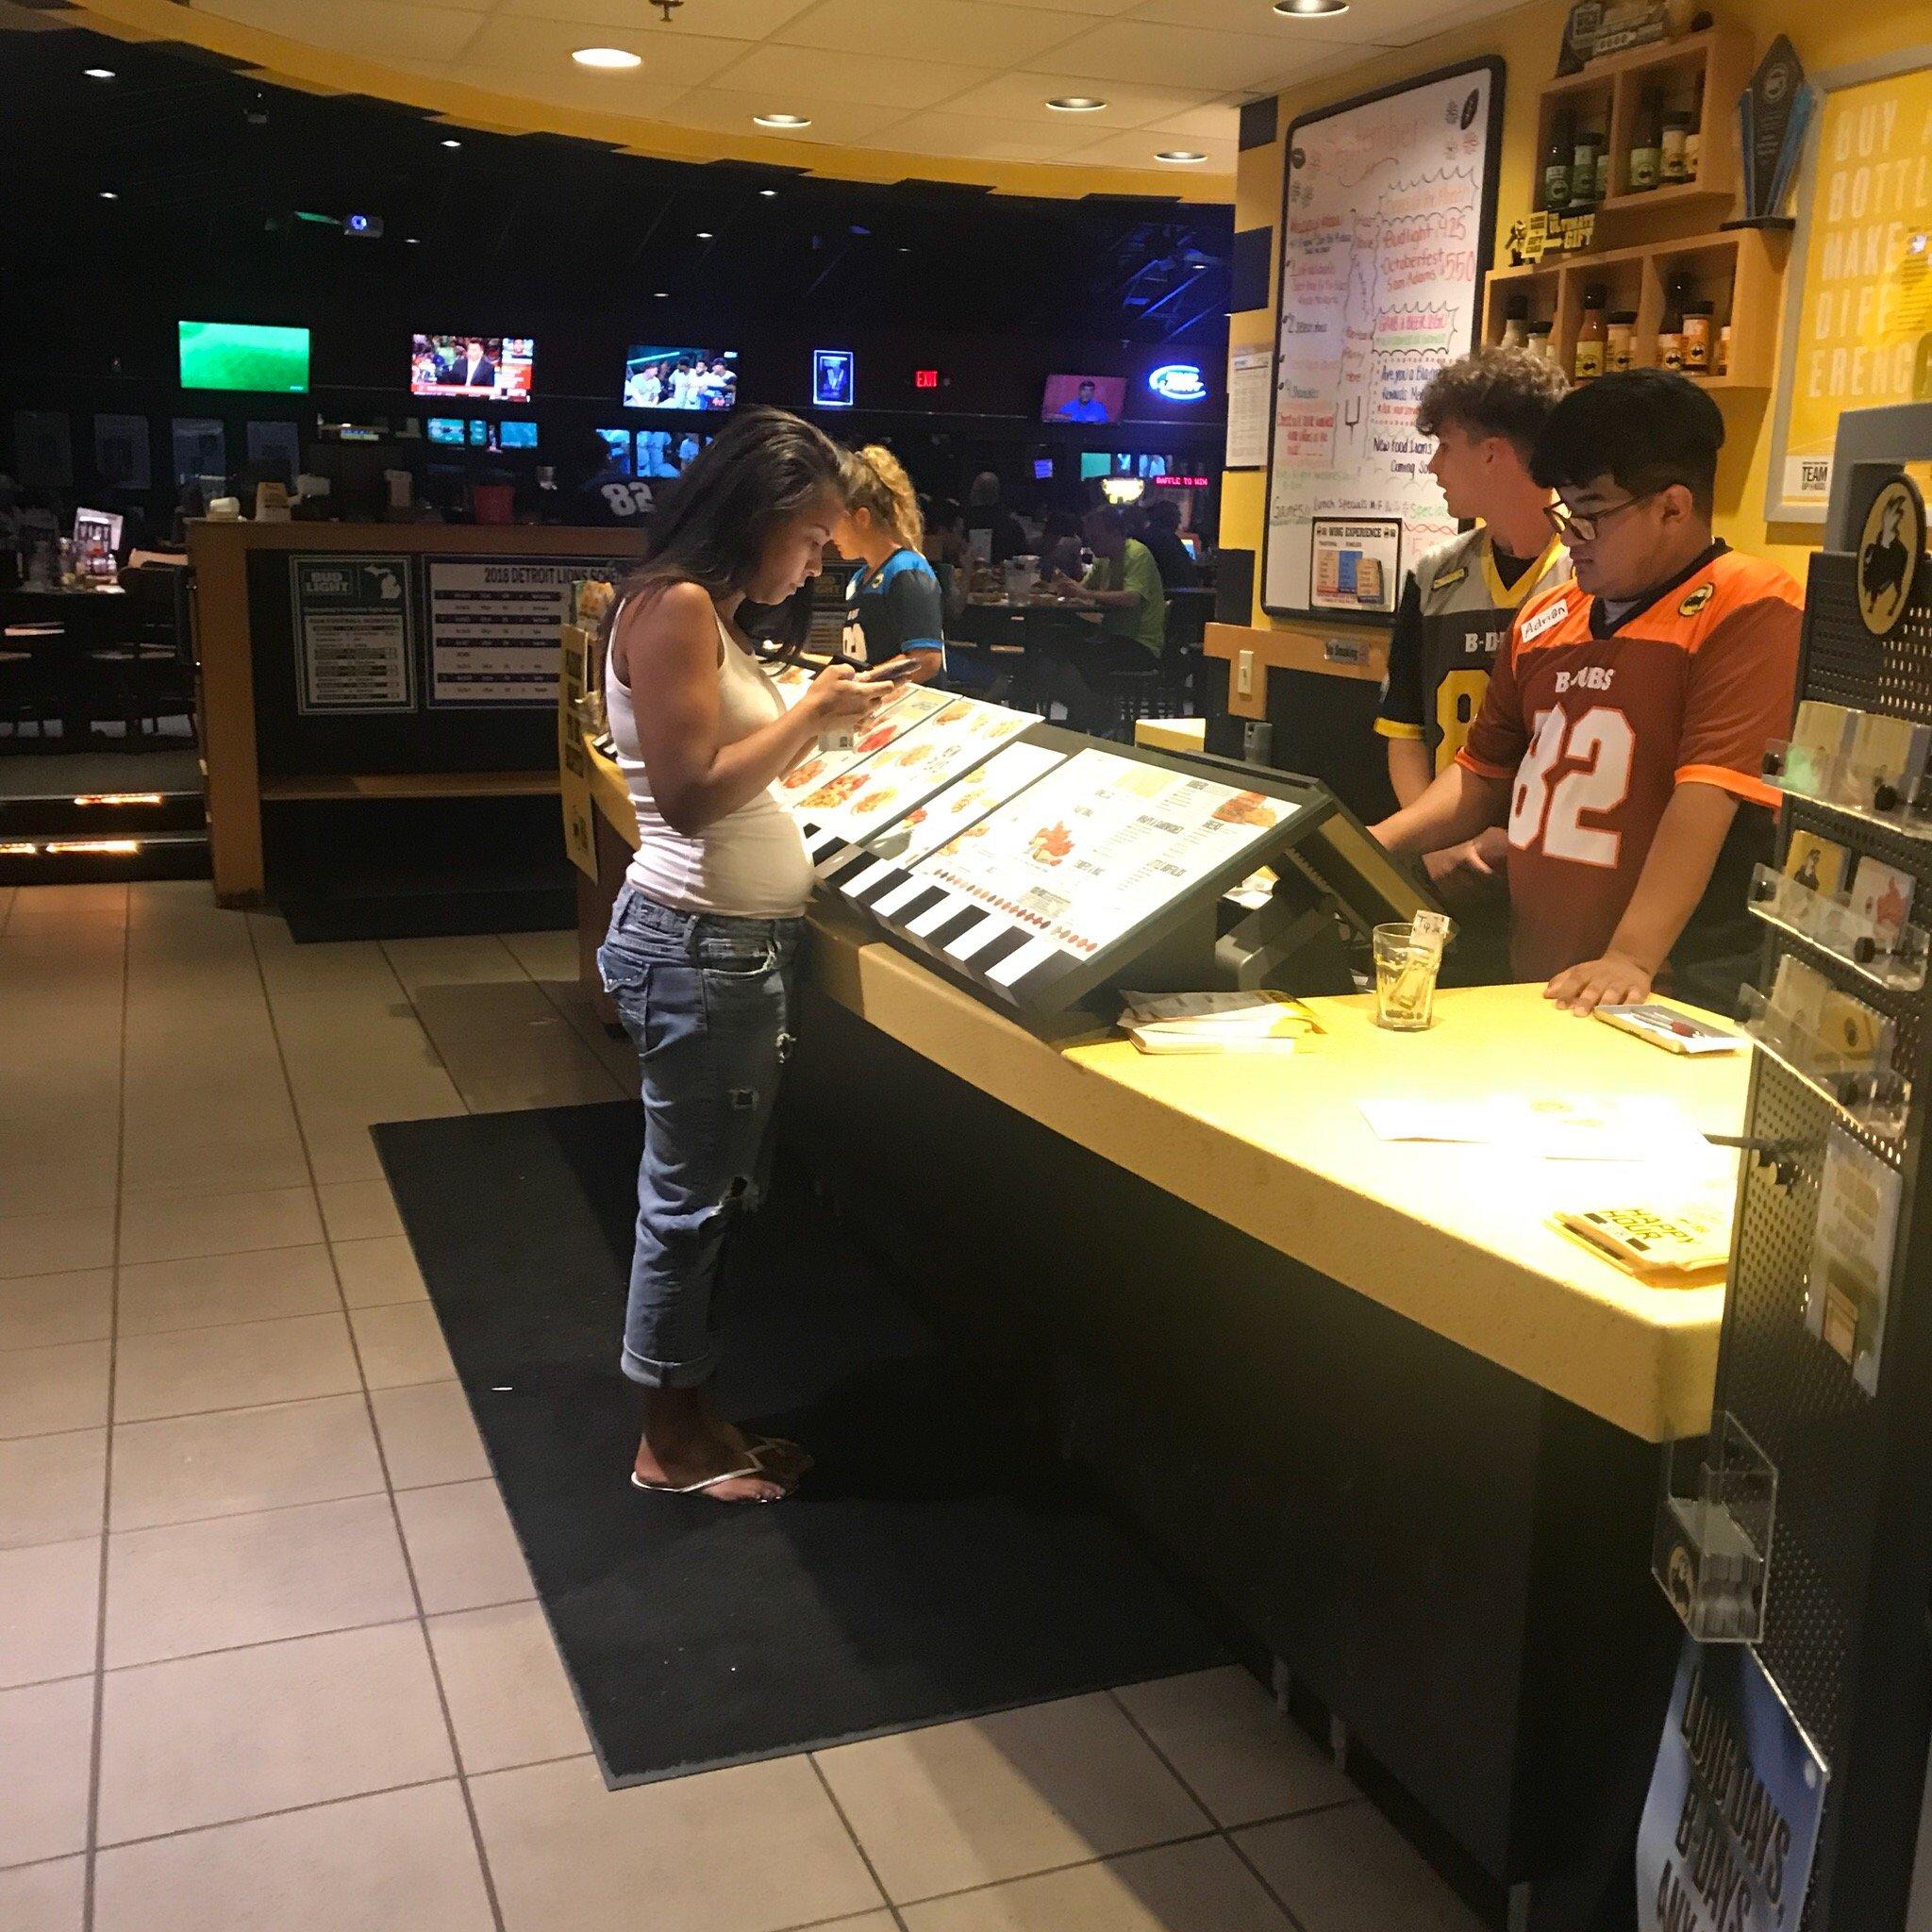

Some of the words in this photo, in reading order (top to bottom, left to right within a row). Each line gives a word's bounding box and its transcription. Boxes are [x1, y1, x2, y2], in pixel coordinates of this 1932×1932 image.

[1835, 99, 1898, 162] BUY
[1827, 156, 1929, 223] BOTTL
[916, 371, 938, 387] EXIT
[1803, 466, 1828, 482] TEAM
[601, 482, 658, 517] 82
[1328, 526, 1343, 537] WING
[1345, 526, 1382, 538] EXPERIENCE
[510, 567, 555, 583] DETROIT
[1524, 607, 1566, 640] Adrian
[1508, 704, 1636, 869] 82
[1600, 1210, 1662, 1240] HOUR
[1628, 1208, 1699, 1244] HAPPY
